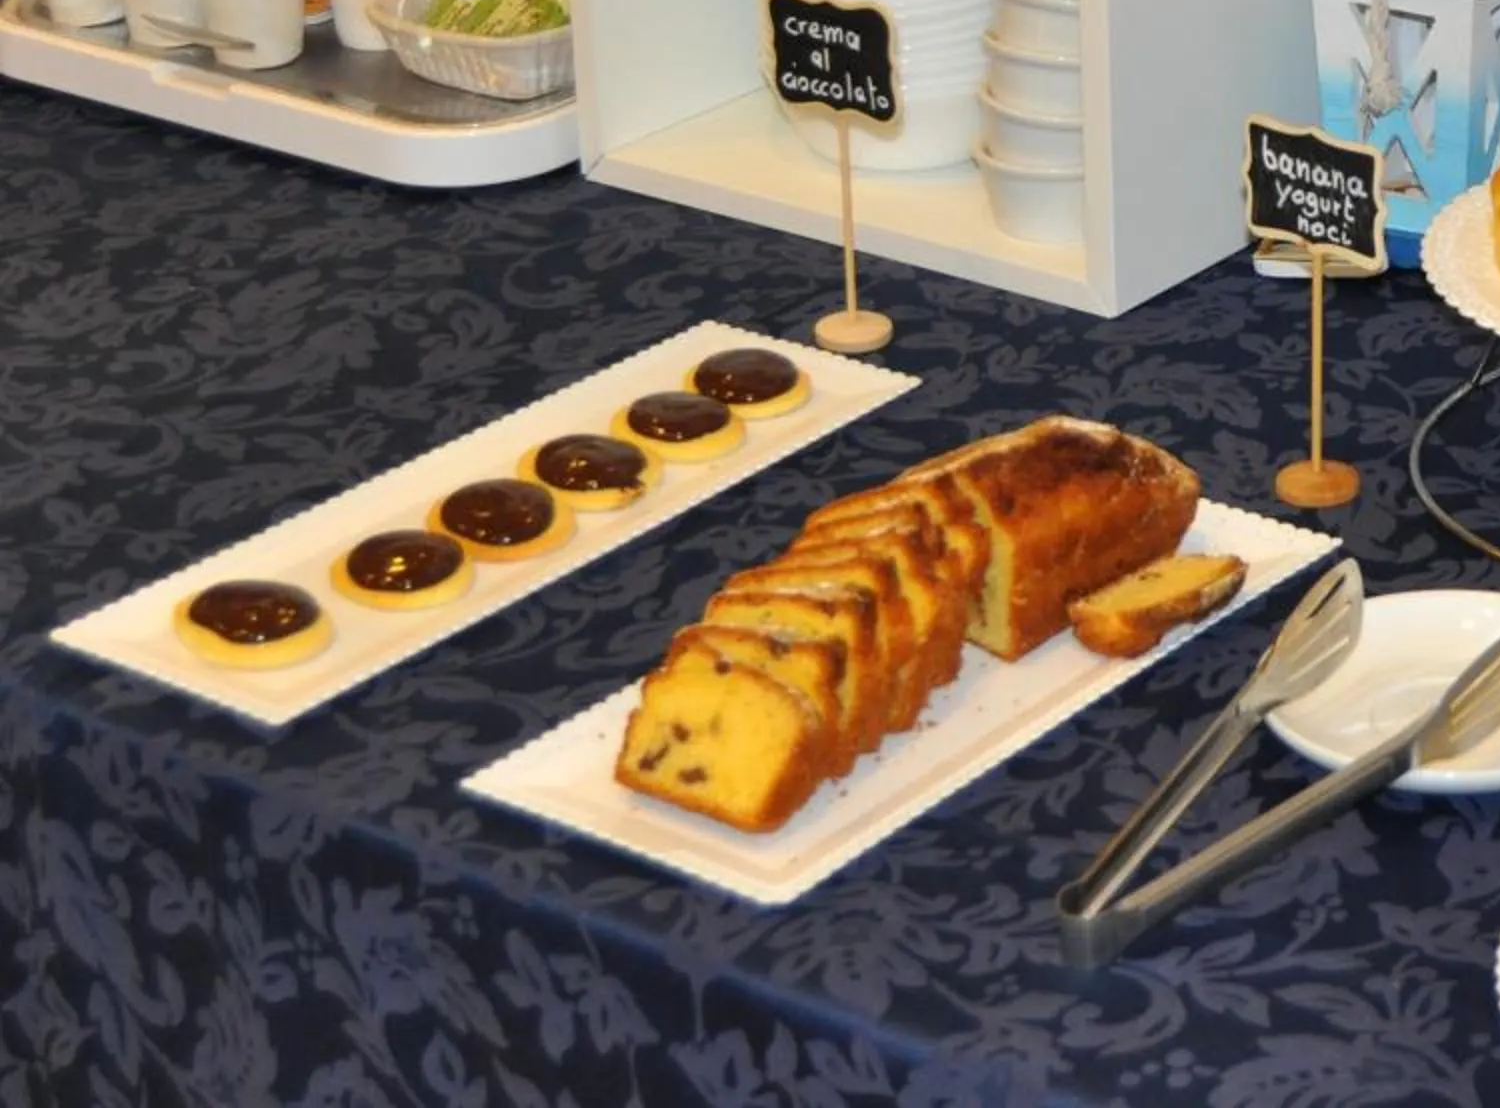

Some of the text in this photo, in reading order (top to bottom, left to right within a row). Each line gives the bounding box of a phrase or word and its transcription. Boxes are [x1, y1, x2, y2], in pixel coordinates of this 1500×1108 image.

[784, 17, 861, 51] crema
[810, 48, 830, 72] al
[781, 60, 889, 110] cioccolato
[1261, 133, 1368, 199] banana
[1276, 179, 1356, 223] yogurt
[1297, 213, 1352, 245] noci
